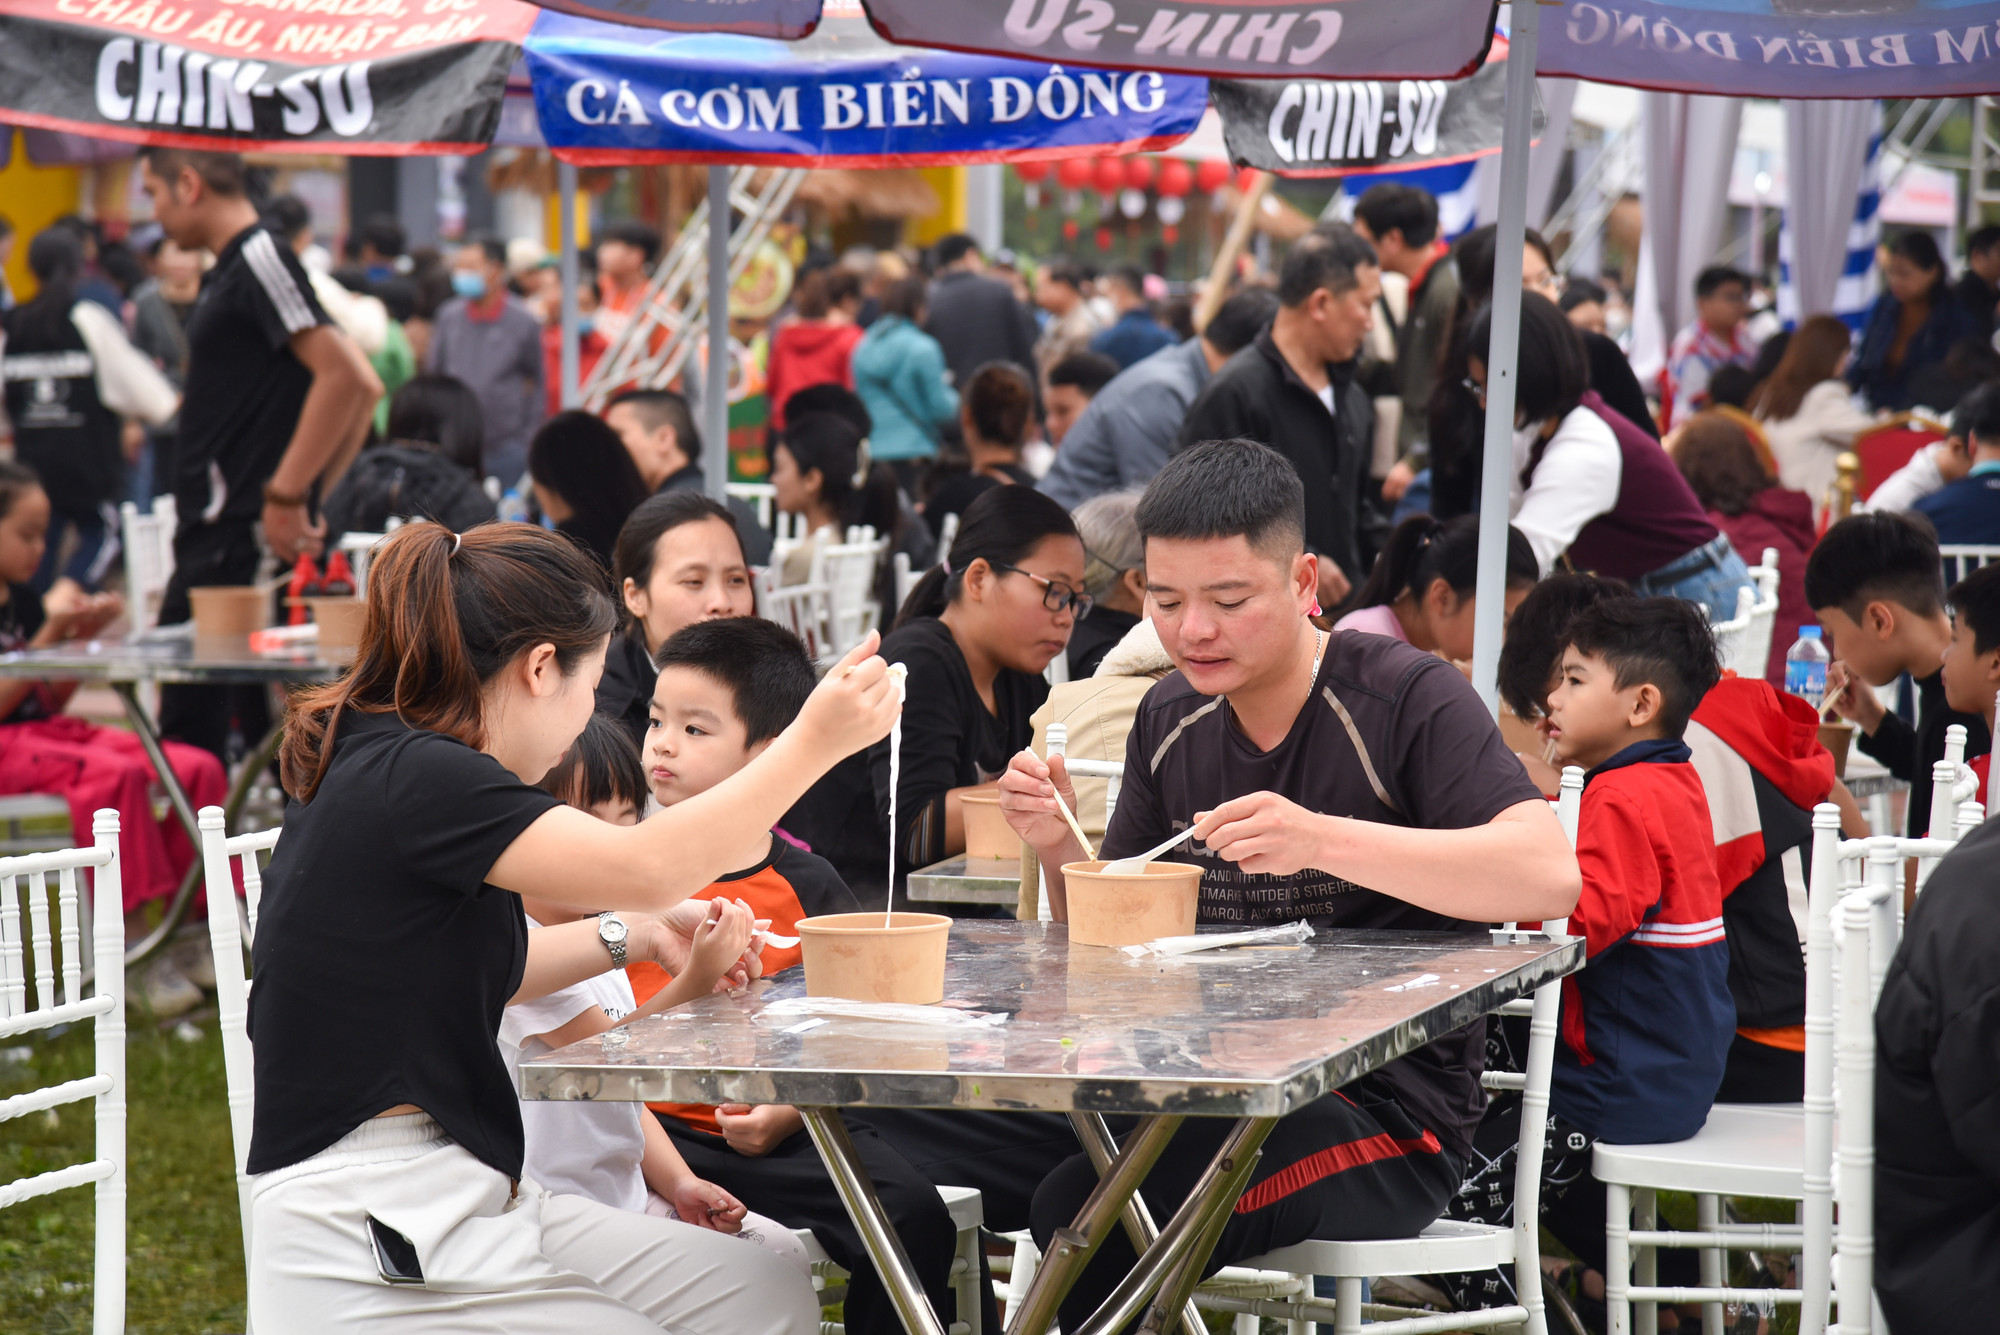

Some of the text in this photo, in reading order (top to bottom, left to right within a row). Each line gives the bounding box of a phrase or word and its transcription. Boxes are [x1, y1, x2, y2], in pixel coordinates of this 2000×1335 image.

[95, 37, 373, 136] CHIN-SU
[659, 83, 802, 132] CƠM
[820, 66, 971, 130] BIỂN
[988, 64, 1167, 121] ĐÔNG
[1268, 80, 1448, 163] CHIN-SU
[1199, 887, 1242, 902] TMARKE
[1293, 887, 1300, 899] 3
[1304, 881, 1361, 898] STREIFE
[1200, 869, 1231, 882] RAND
[1251, 908, 1271, 920] AUX
[1275, 908, 1282, 919] 3
[1286, 901, 1334, 918] BANDES
